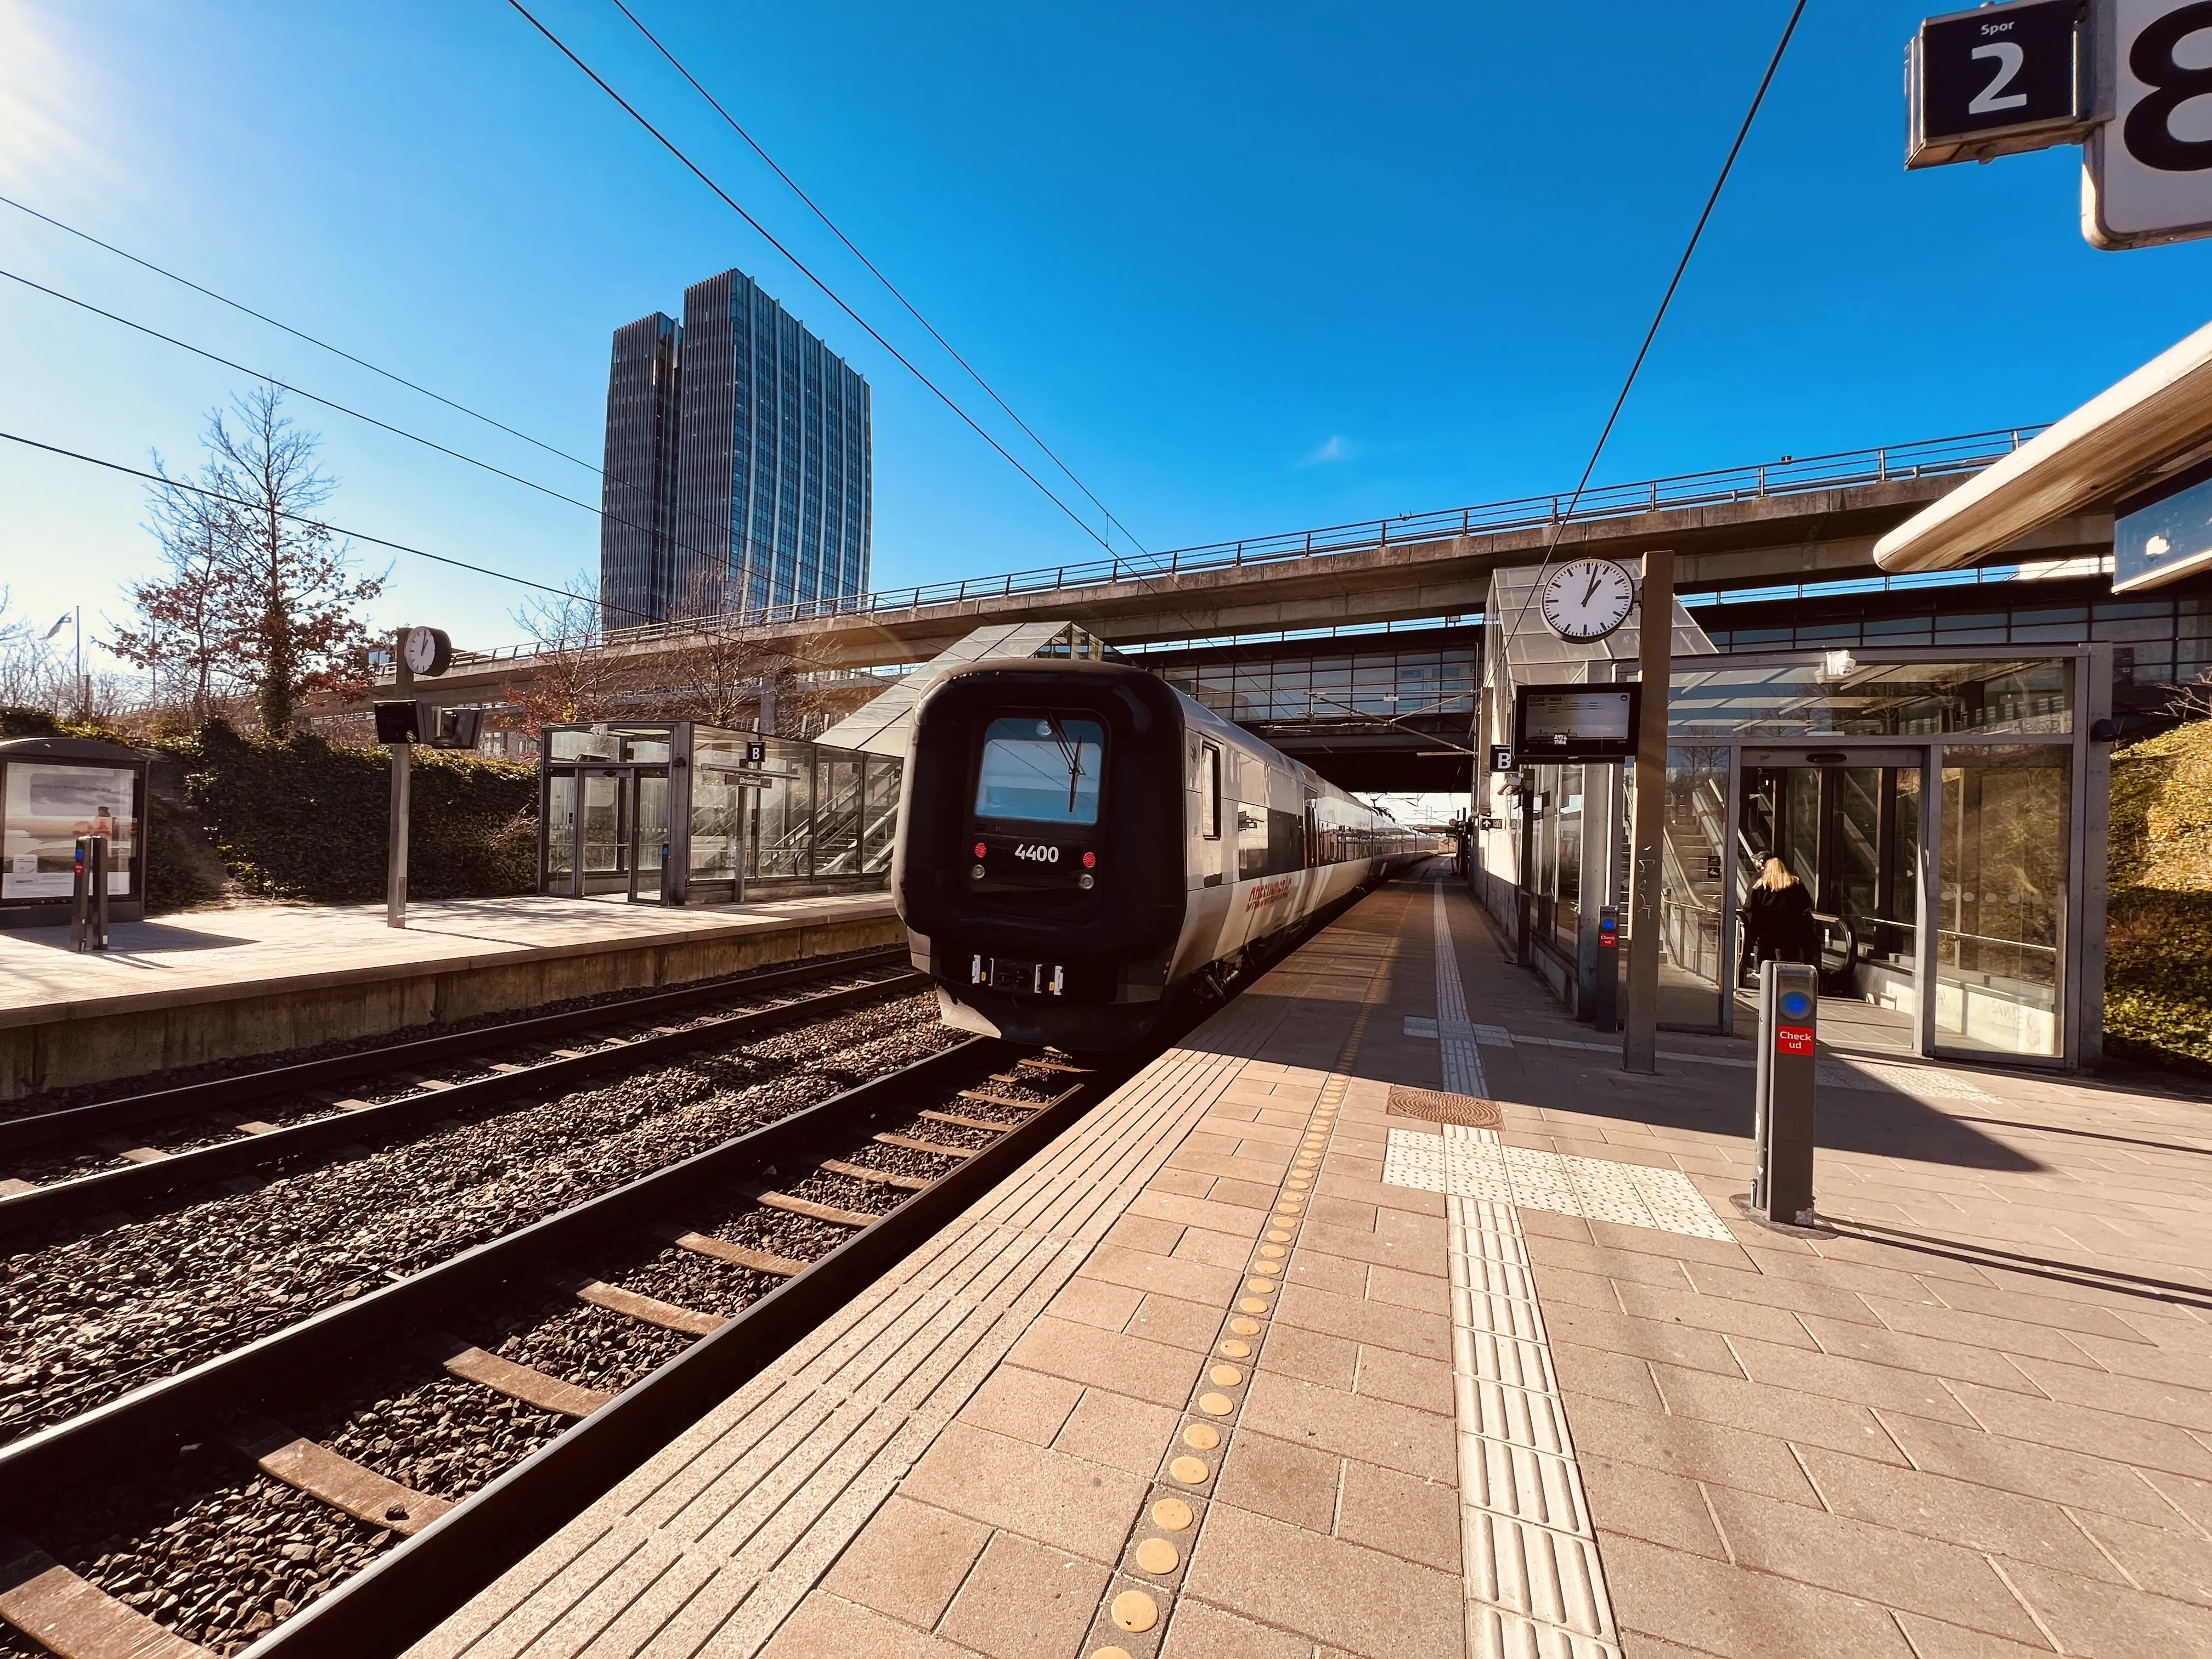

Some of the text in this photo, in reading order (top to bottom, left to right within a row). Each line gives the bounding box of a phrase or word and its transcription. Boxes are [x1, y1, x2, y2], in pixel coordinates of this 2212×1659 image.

[1981, 21, 2015, 36] Spor
[1968, 42, 2027, 115] 2
[752, 747, 760, 759] B
[1498, 753, 1511, 769] B
[1015, 844, 1059, 862] 4400
[1780, 1031, 1812, 1041] Check
